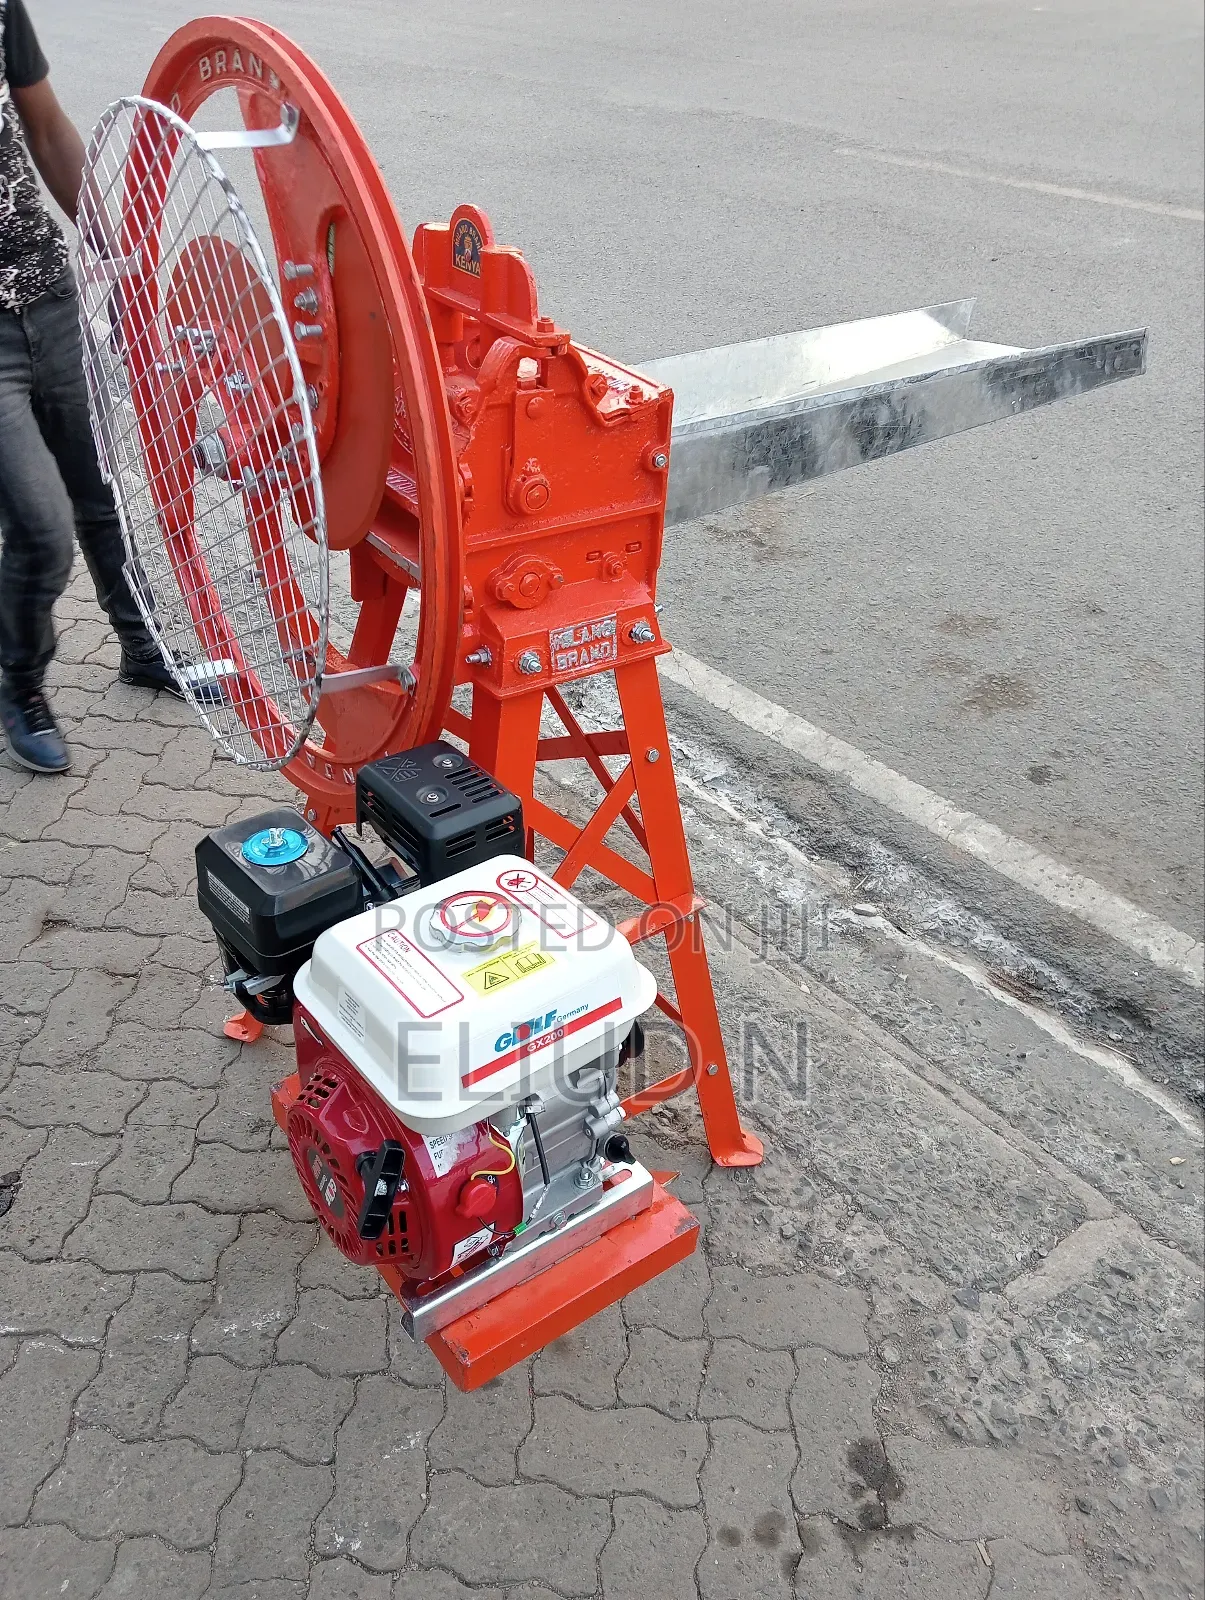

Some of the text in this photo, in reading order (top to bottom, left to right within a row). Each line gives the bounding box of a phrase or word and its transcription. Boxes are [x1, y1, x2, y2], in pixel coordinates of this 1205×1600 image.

[455, 253, 481, 275] KENYA
[556, 641, 612, 671] BRAND
[494, 1003, 589, 1053] GOLF Germany
[527, 1028, 565, 1053] GX200
